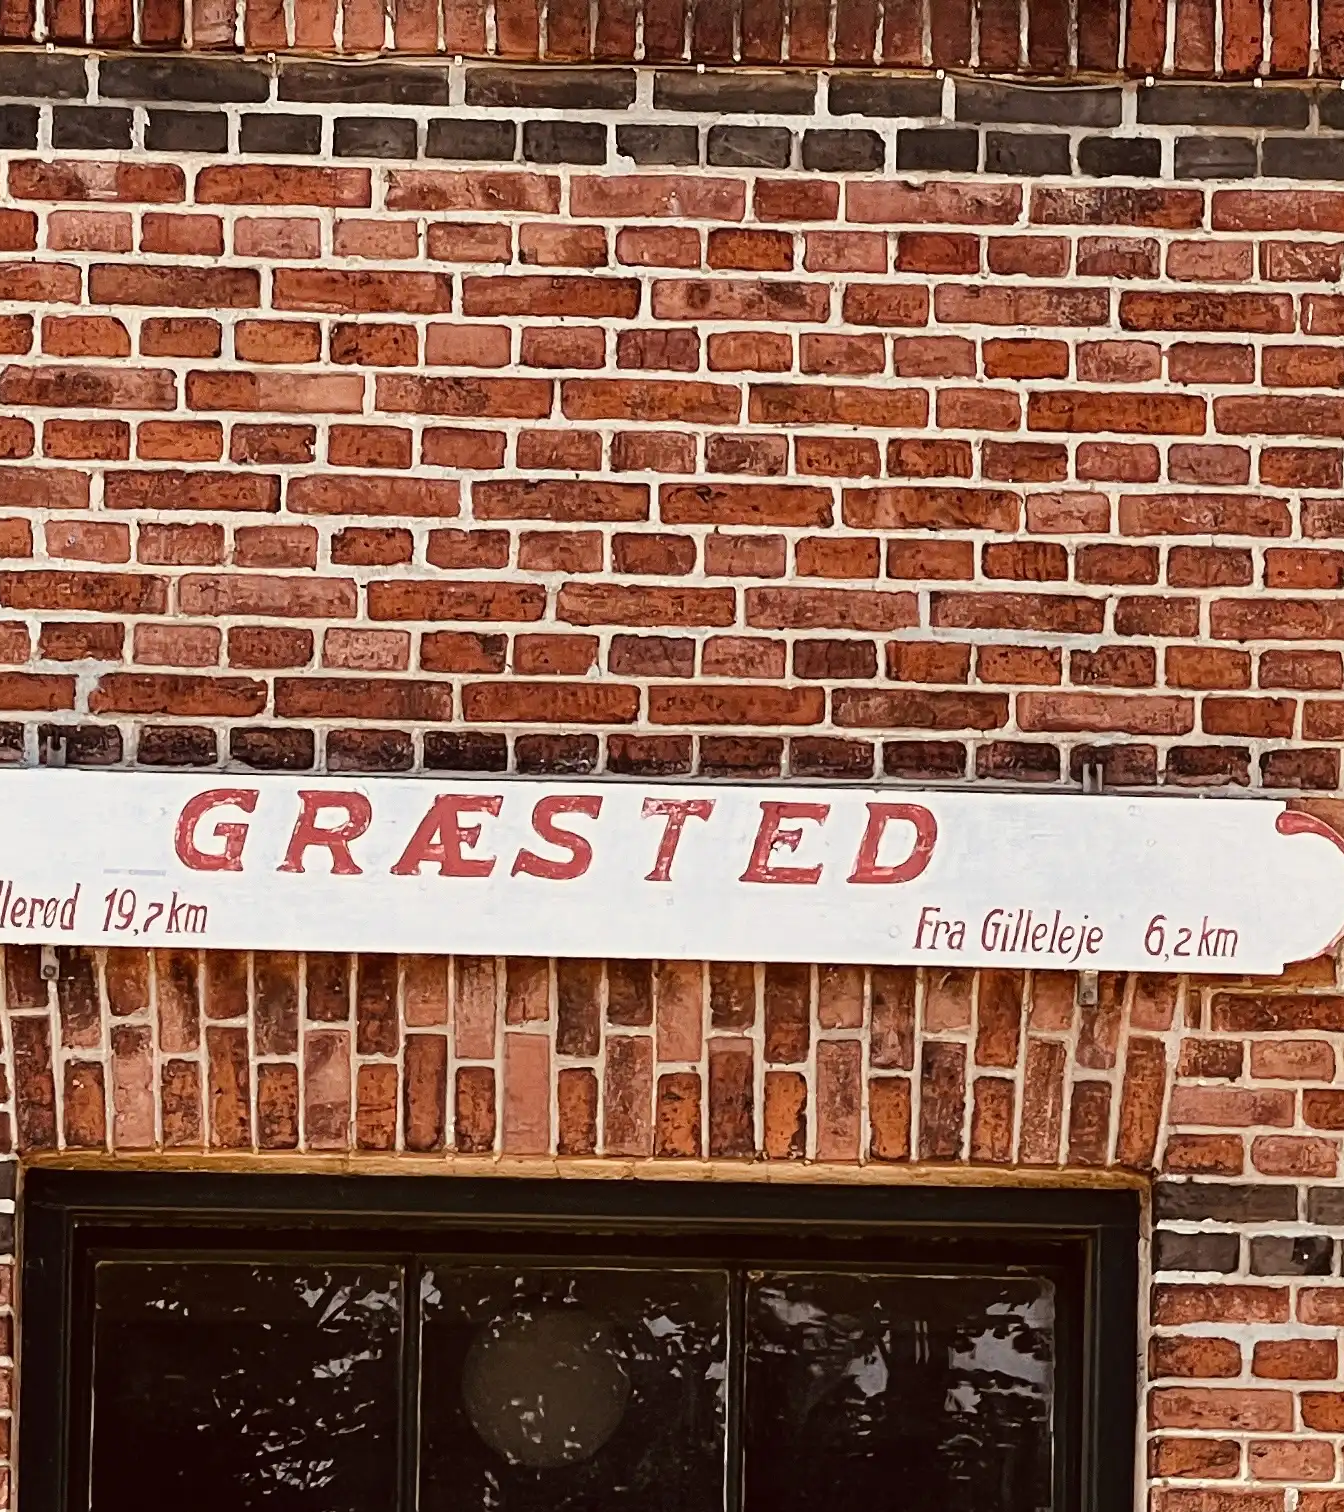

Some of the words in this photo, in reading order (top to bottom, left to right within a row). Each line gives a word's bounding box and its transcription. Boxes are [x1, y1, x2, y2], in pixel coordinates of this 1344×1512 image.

[175, 787, 938, 886] GRÆSTED
[912, 907, 965, 951] Fra
[981, 908, 1104, 963] Gilleleje
